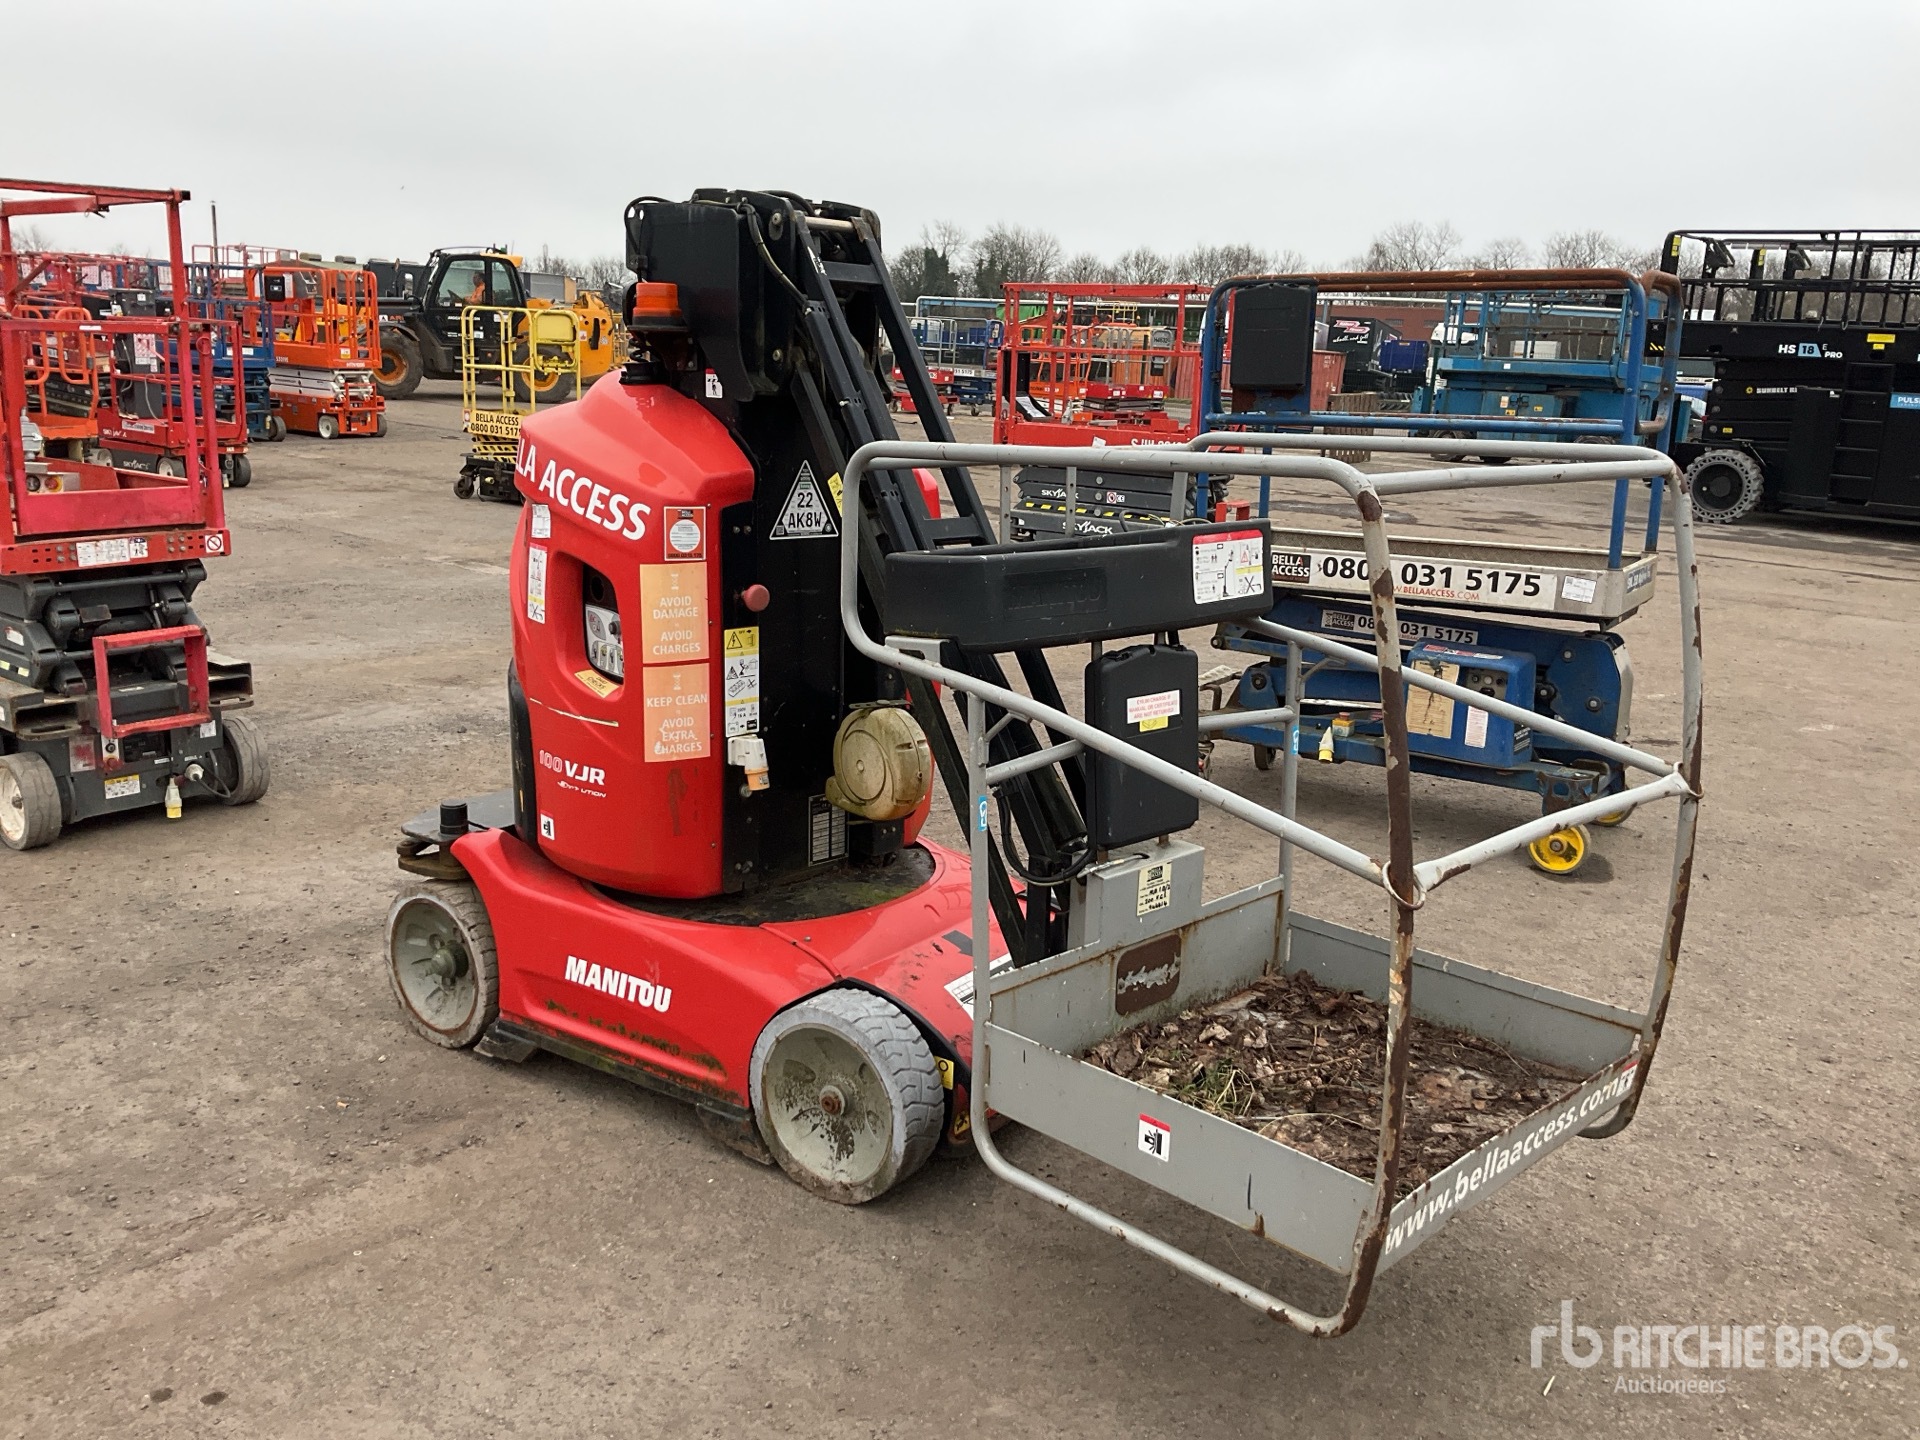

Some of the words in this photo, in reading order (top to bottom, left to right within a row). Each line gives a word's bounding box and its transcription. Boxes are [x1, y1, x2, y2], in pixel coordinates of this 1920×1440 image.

[1778, 344, 1796, 354] HS
[1802, 345, 1815, 355] 18
[1822, 343, 1828, 351] E
[1824, 351, 1843, 359] PRO
[1897, 396, 1920, 404] PULS
[476, 413, 493, 423] BELLA
[495, 416, 519, 426] ACCESS
[471, 423, 488, 432] 0800
[490, 426, 502, 434] 031
[538, 459, 652, 541] ACCESS
[1041, 488, 1080, 499] SKYJAK
[797, 492, 814, 509] 22
[788, 511, 822, 529] AK8W
[1271, 553, 1304, 567] BELLA
[1271, 566, 1310, 578] ACCESS
[1322, 556, 1370, 581] 080
[1401, 563, 1452, 588] 031
[1465, 568, 1541, 597] 5175
[660, 595, 692, 608] AVOID
[652, 606, 699, 620] DAMAGE
[1333, 612, 1351, 621] BELLA
[1332, 618, 1355, 628] ACCESS
[660, 630, 693, 642] AVOID
[1400, 622, 1429, 637] 031
[1434, 627, 1474, 644] 5175
[652, 642, 701, 656] CHARGES
[646, 697, 673, 708] KEEP
[675, 693, 708, 706] CLEAN
[662, 717, 695, 729] AVOID
[662, 730, 696, 742] EXTRA
[654, 742, 703, 755] CHARGES
[539, 749, 562, 773] 100
[564, 760, 605, 786] VJR
[564, 955, 672, 1013] MANITOU
[1385, 1077, 1620, 1255] www.bellaaccess.com
